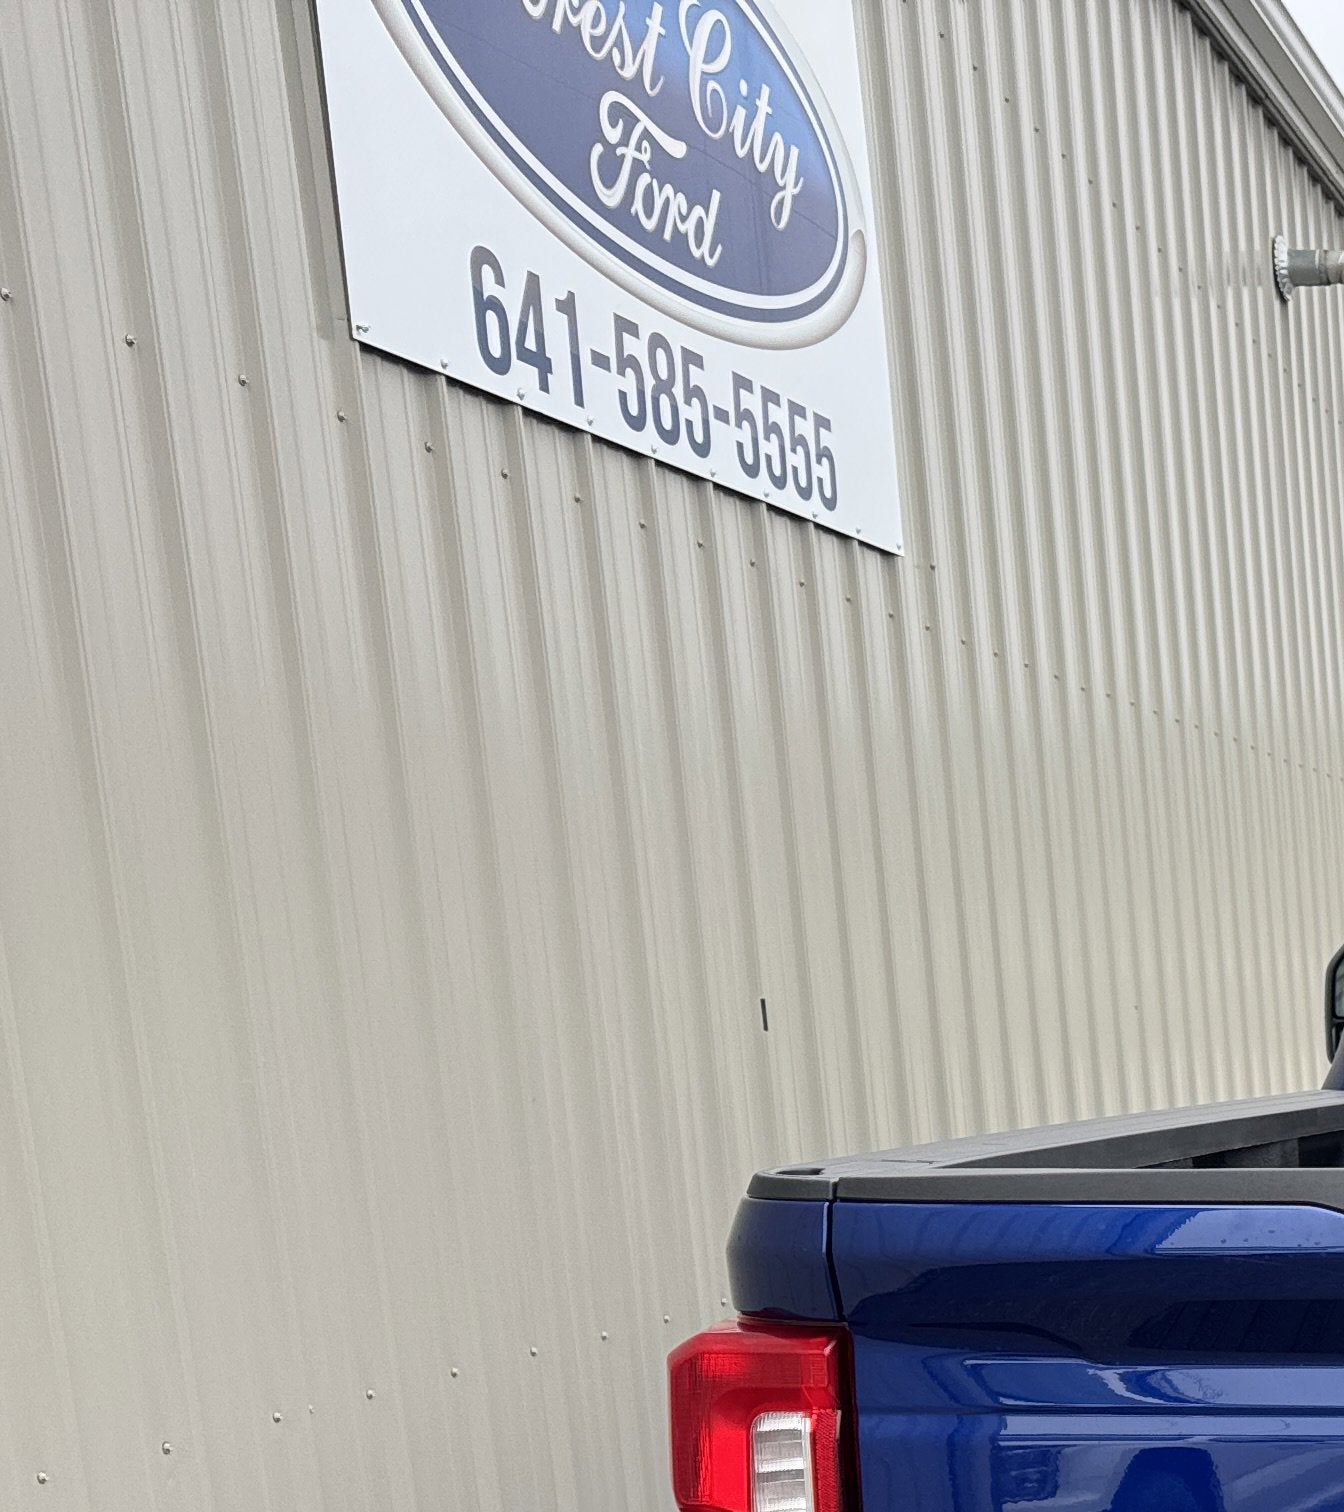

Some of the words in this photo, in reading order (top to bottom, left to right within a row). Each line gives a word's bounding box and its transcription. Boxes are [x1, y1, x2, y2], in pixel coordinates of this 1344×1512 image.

[590, 90, 722, 268] Ford
[678, 0, 803, 231] City
[469, 245, 838, 512] 641-585-5555
